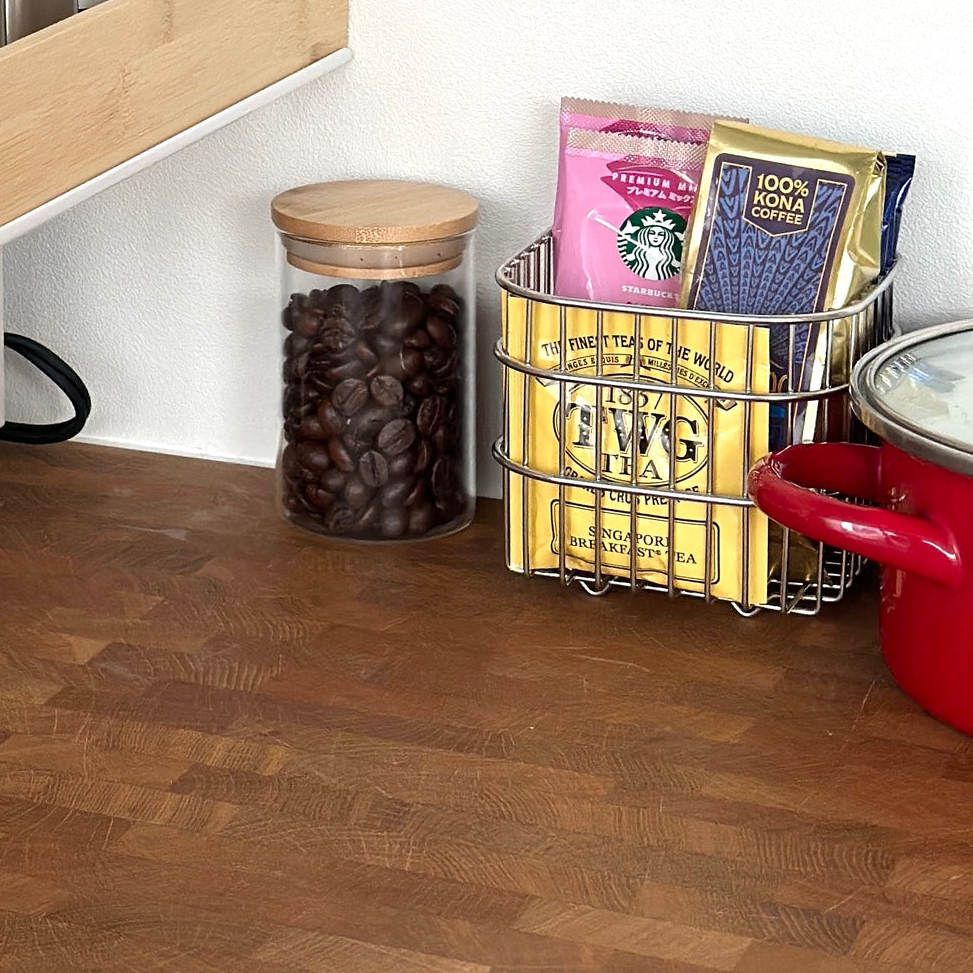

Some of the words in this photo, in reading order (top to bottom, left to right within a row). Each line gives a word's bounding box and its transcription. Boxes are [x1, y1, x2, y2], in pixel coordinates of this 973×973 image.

[611, 172, 670, 189] PREMIUM
[756, 173, 809, 197] 100%
[627, 186, 667, 200] プレミアム
[753, 190, 805, 214] KONA
[751, 206, 804, 225] COFFEE
[542, 340, 561, 357] TH
[568, 335, 609, 351] FINET
[647, 338, 663, 352] OF
[565, 401, 704, 464] TWG
[588, 525, 669, 547] SNGAPOR
